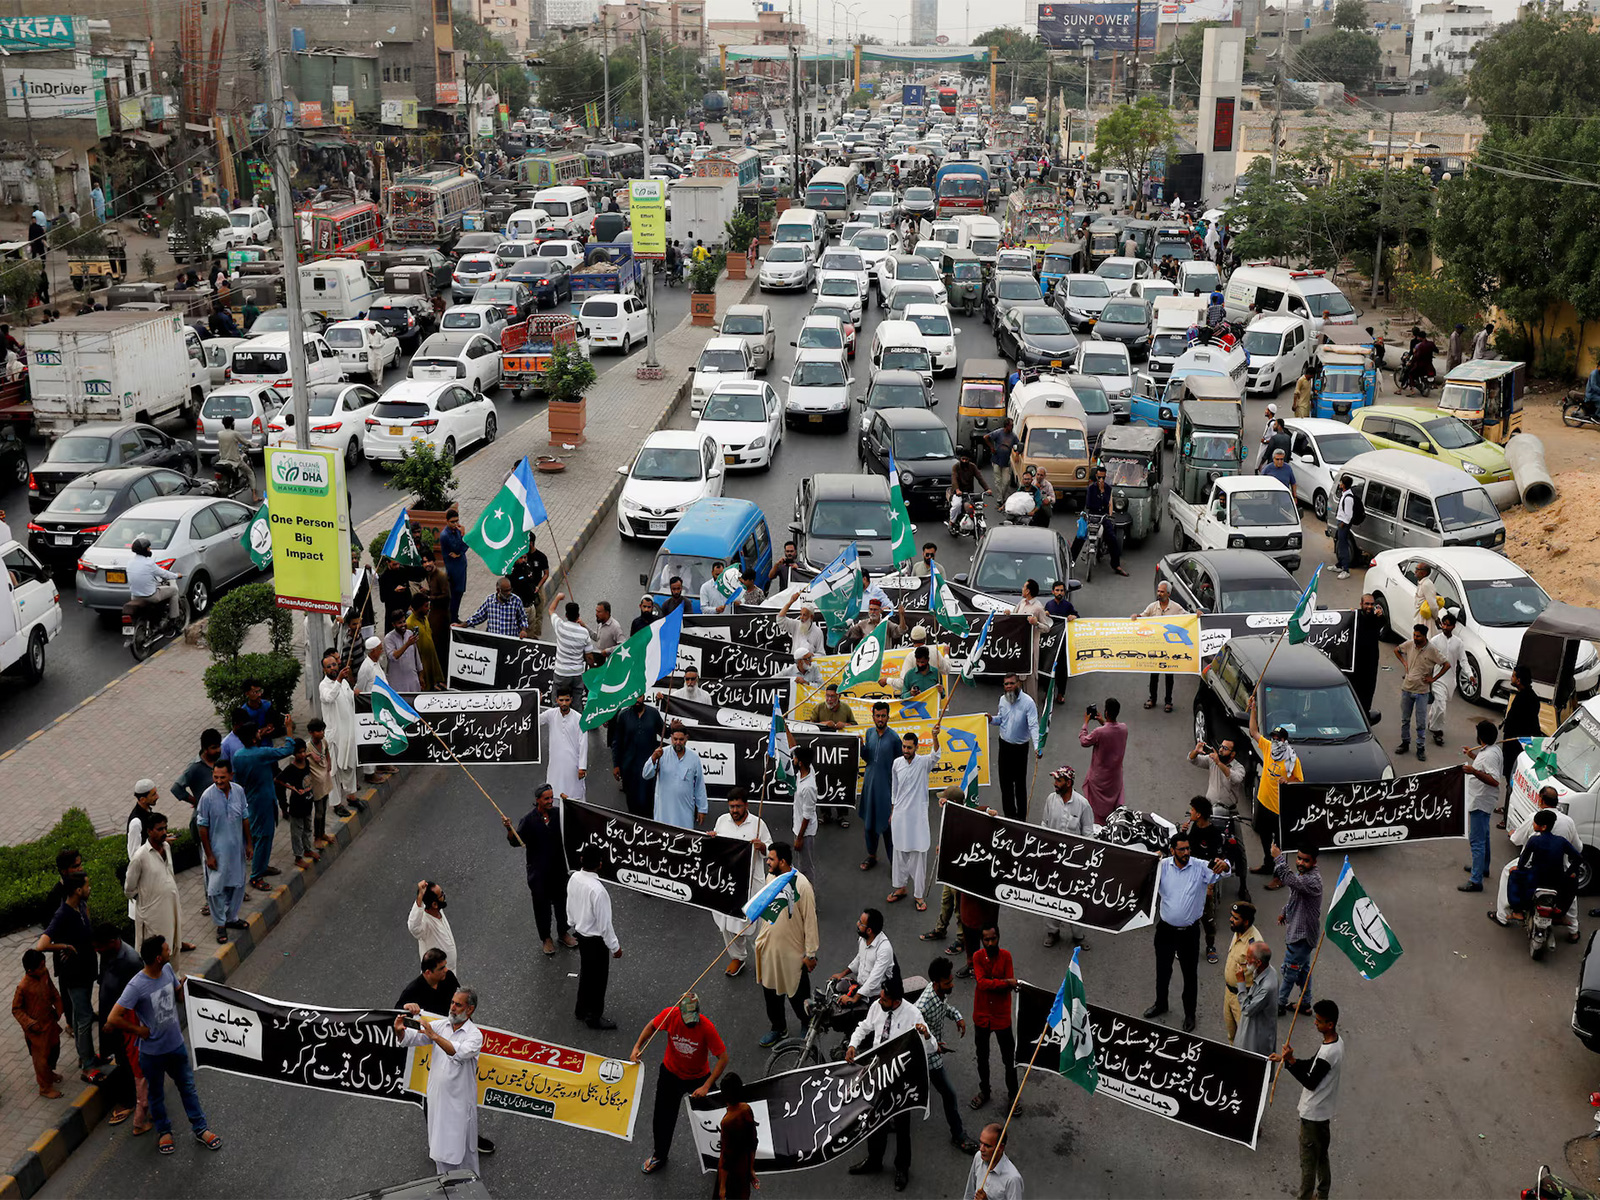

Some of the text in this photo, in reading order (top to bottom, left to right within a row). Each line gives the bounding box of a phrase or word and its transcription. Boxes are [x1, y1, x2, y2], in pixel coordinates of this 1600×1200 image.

[0, 17, 68, 38] YKEA
[1063, 15, 1130, 25] SUNPOWER
[30, 83, 87, 94] inDriver
[696, 303, 710, 313] CBC
[303, 472, 322, 482] DHA
[272, 514, 334, 528] One Person
[295, 533, 312, 545] Big
[286, 549, 324, 561] Impact
[278, 597, 339, 611] #CleanAndGreenDHA
[739, 617, 757, 638] کرو
[455, 649, 491, 666] جماعت
[505, 644, 540, 674] ختم کرو
[988, 635, 1021, 658] پٹرول کی
[457, 663, 485, 676] اسلامی
[709, 645, 773, 676] کی غلامی ختم کرو
[445, 697, 513, 710] پٹرول قیمت اضافہ
[714, 685, 788, 706] IMF غلامی
[449, 714, 514, 744] سڑکوں ظلم
[457, 739, 512, 759] احتجاج کا حصہ
[744, 735, 849, 765] IMF کرو
[817, 775, 846, 801] پٹرول
[1325, 775, 1419, 806] نکلو گے تو مسئلہ حل ہوگا
[1365, 794, 1452, 826] پٹرول کی قیمتوں میں
[606, 819, 702, 856] نکلو گے تو مسئلہ حل ہوگا
[992, 828, 1106, 870] نکلو گے تو مسئلہ حل ہوگا
[1338, 829, 1403, 844] جماعت اسلامی
[622, 872, 687, 899] جماعت اسلامی
[649, 857, 737, 895] پٹرول کی قیمتوں میں
[1001, 888, 1077, 919] جماعت اسلامی
[1037, 871, 1139, 911] پٹرول کی قیمتوں میں
[1332, 920, 1376, 969] جماعت اسلامی
[197, 1006, 254, 1033] جماعت
[273, 1008, 369, 1045] کی غلامی ختم کرو
[205, 1028, 246, 1048] اسلامی
[1098, 1017, 1203, 1063] نکلو گے تو مسئلہ حل
[281, 1042, 372, 1088] کی قیمت کم کرو
[498, 1039, 582, 1068] ہفتہ 2 ستمبر ملک گیر
[478, 1068, 599, 1102] بجلی اور کی قیمتوں میں
[782, 1050, 912, 1125] IMF کی غلامی ختم کرو
[1125, 1061, 1242, 1115] پٹرول کی قیمتوں میں
[486, 1091, 552, 1113] جماعت اسلامی کراچی جنوبی
[1125, 1087, 1173, 1116] جماعت
[797, 1081, 918, 1162] پٹرول کم کرو
